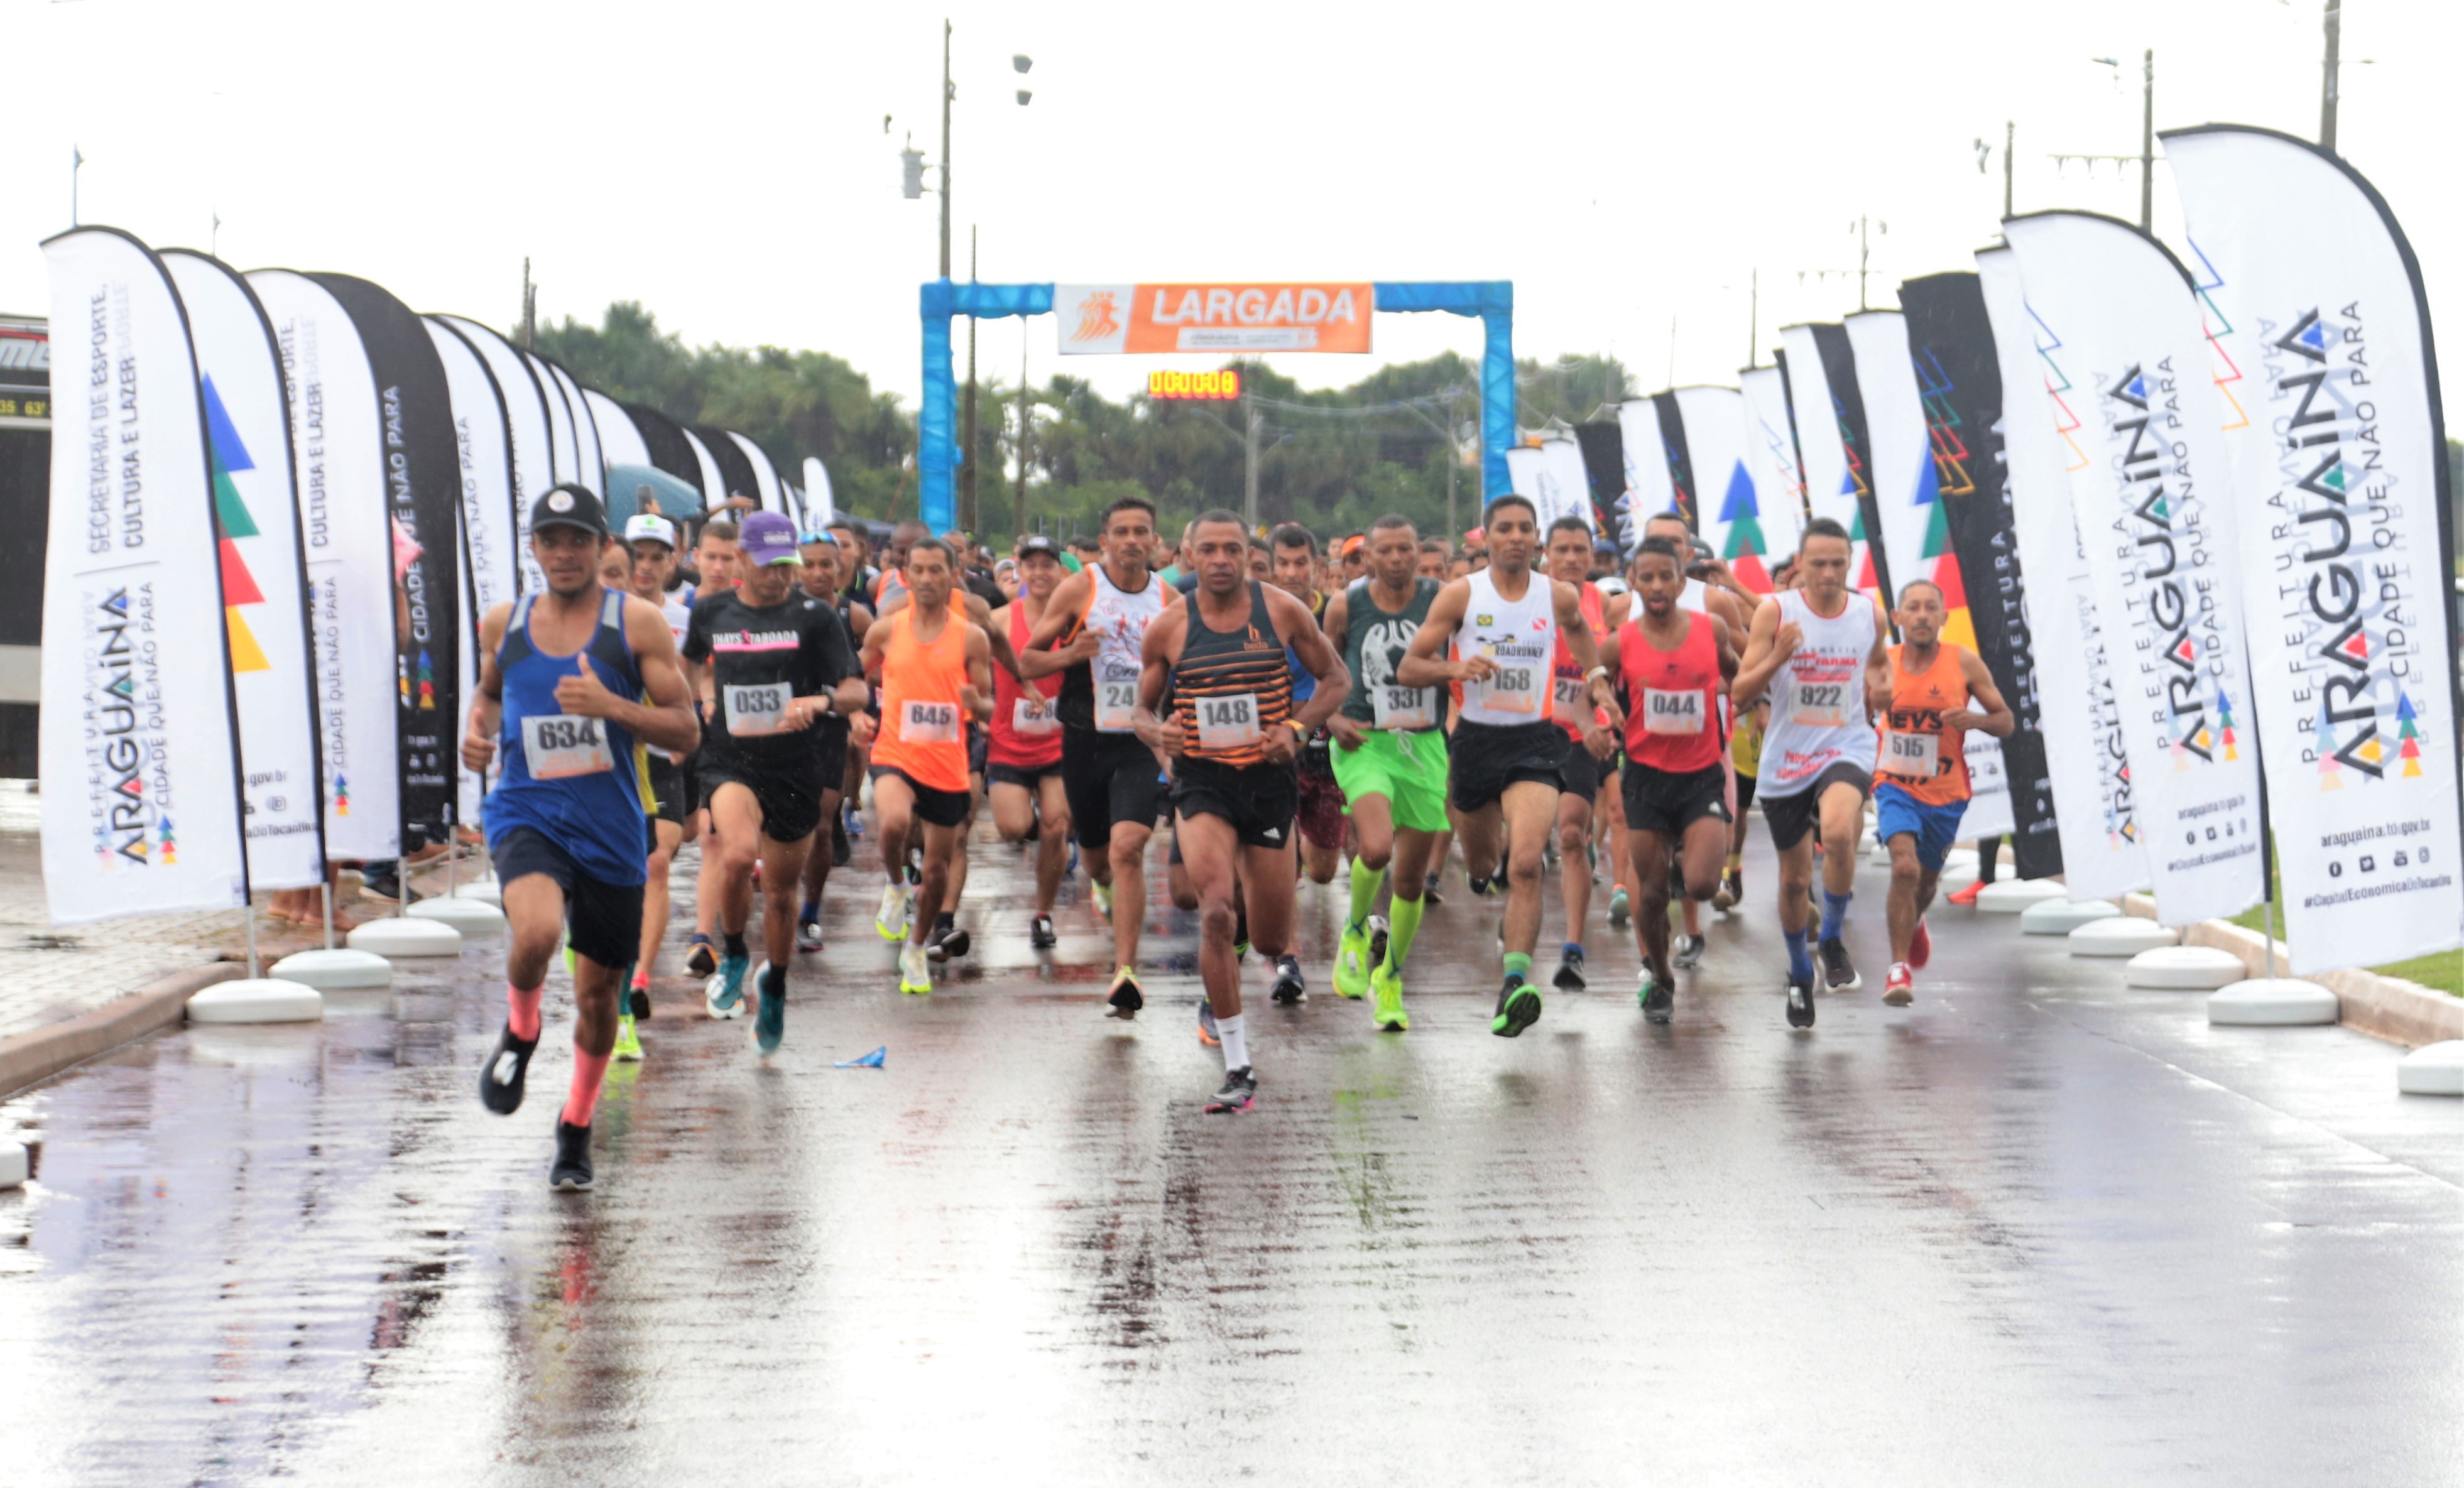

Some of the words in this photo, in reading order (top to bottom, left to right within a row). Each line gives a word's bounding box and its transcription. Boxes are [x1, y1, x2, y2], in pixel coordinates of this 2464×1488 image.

[1152, 288, 1357, 325] LARGADA
[2341, 300, 2370, 386] PARA
[91, 392, 109, 418] DE
[119, 356, 139, 428] LAZER
[307, 382, 323, 439] LAZER
[383, 385, 403, 445] PARA
[2157, 355, 2183, 429] PARA
[121, 430, 139, 447] E
[308, 447, 323, 458] E
[2355, 400, 2383, 470] NÃO
[90, 426, 110, 555] SECRETARIA
[390, 453, 413, 503] NÃO
[2172, 442, 2195, 501] NÃO
[121, 452, 143, 548] CULTURA
[308, 465, 328, 548] CULTURA
[2368, 484, 2396, 548] QUE
[2185, 511, 2209, 568] QUE
[139, 581, 155, 633] PARA
[325, 577, 337, 620] PARA
[406, 561, 430, 643] CIDADE
[2377, 562, 2409, 678] CIDADE
[324, 626, 339, 661] NÃO
[1990, 531, 2034, 731] PREFEITURA
[2113, 517, 2171, 749] PREFEITURA
[2198, 577, 2223, 676] CIDADE
[2267, 491, 2320, 763] PREFEITURA
[140, 640, 160, 684] NÃO
[330, 666, 345, 700] QUE
[1494, 668, 1530, 690] 158
[146, 688, 165, 729] QUE
[734, 688, 780, 713] 033
[911, 705, 949, 724] 645
[1106, 685, 1134, 707] 24
[1204, 699, 1250, 726] 148
[1388, 688, 1422, 710] 331
[1653, 695, 1696, 715] 044
[1800, 685, 1841, 706] 822
[330, 708, 346, 766] CIDADE
[538, 718, 599, 749] 634
[1892, 735, 1924, 757] 515
[150, 737, 172, 807] CIDADE
